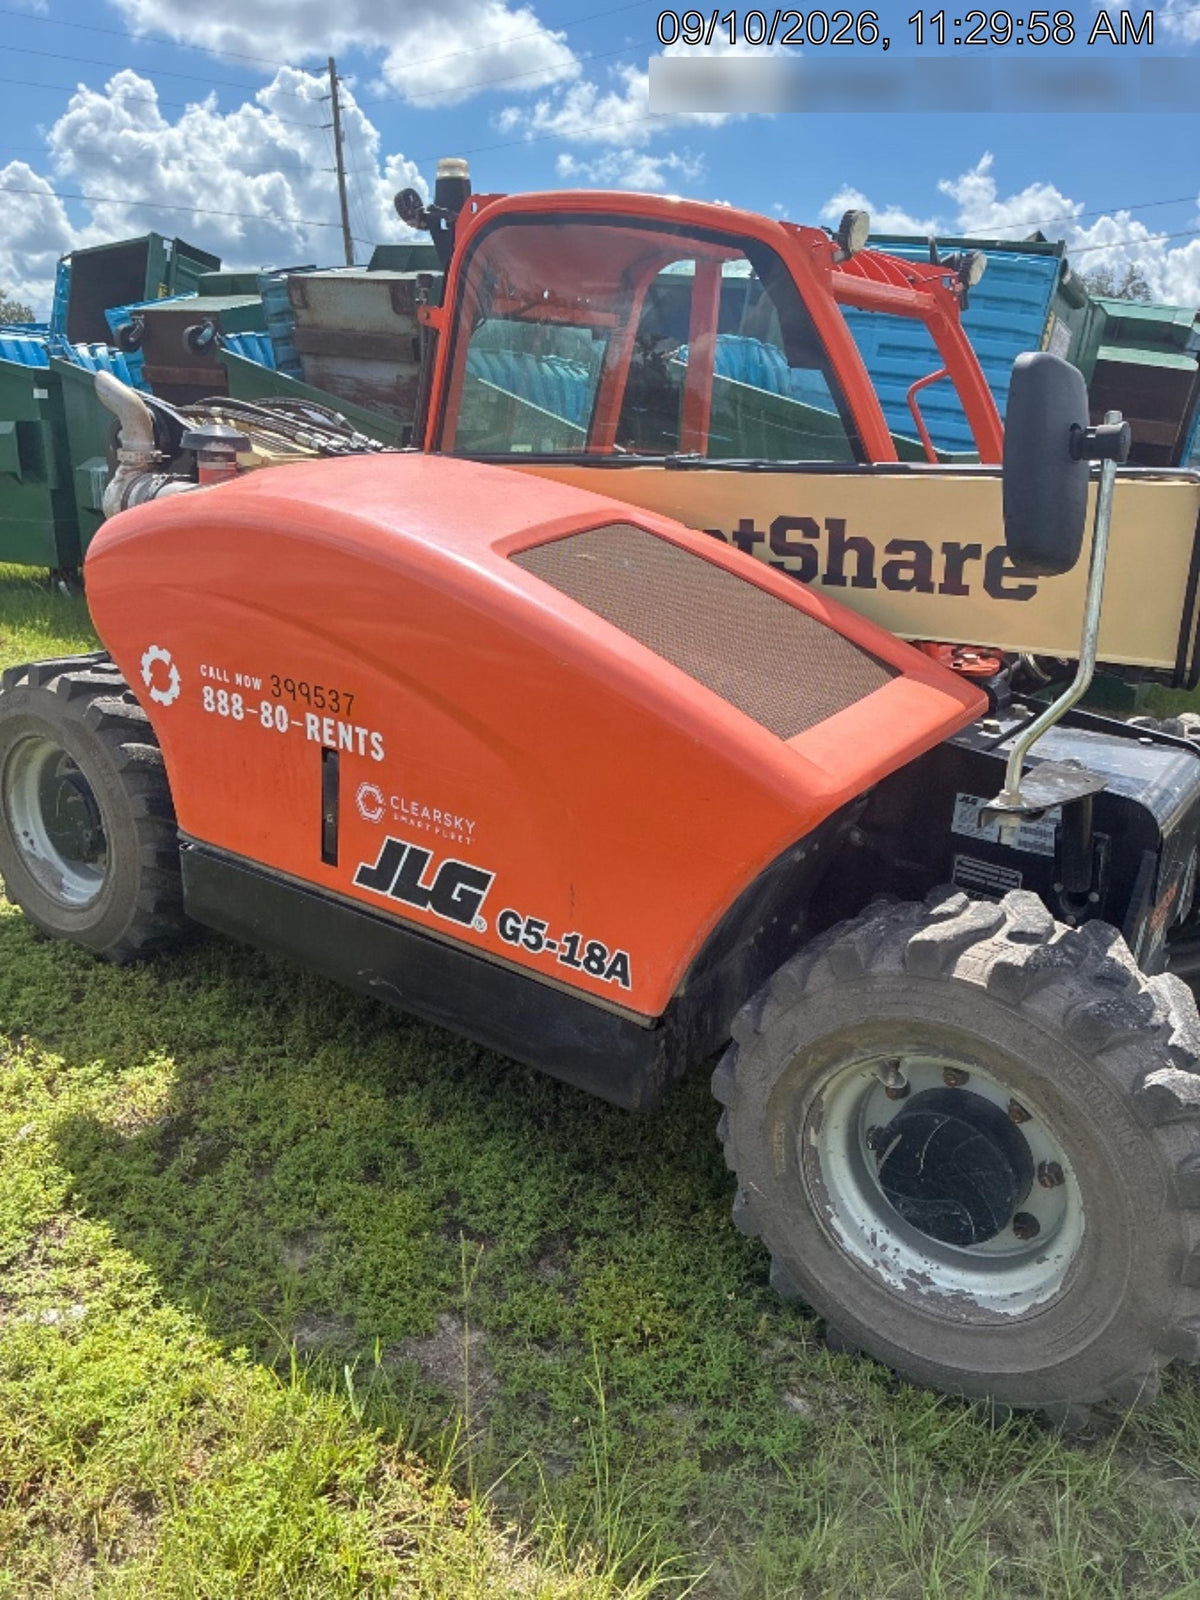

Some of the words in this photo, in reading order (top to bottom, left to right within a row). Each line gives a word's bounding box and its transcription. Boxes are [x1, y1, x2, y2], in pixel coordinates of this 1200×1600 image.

[701, 514, 1038, 602] tShare
[200, 663, 229, 683] CALL
[235, 672, 262, 691] NOW
[270, 674, 355, 716] 399537
[202, 685, 385, 762] 888-80-RENTS
[390, 795, 475, 835] CLEARSKY
[352, 835, 496, 929] JLG
[496, 907, 632, 991] G5-18A
